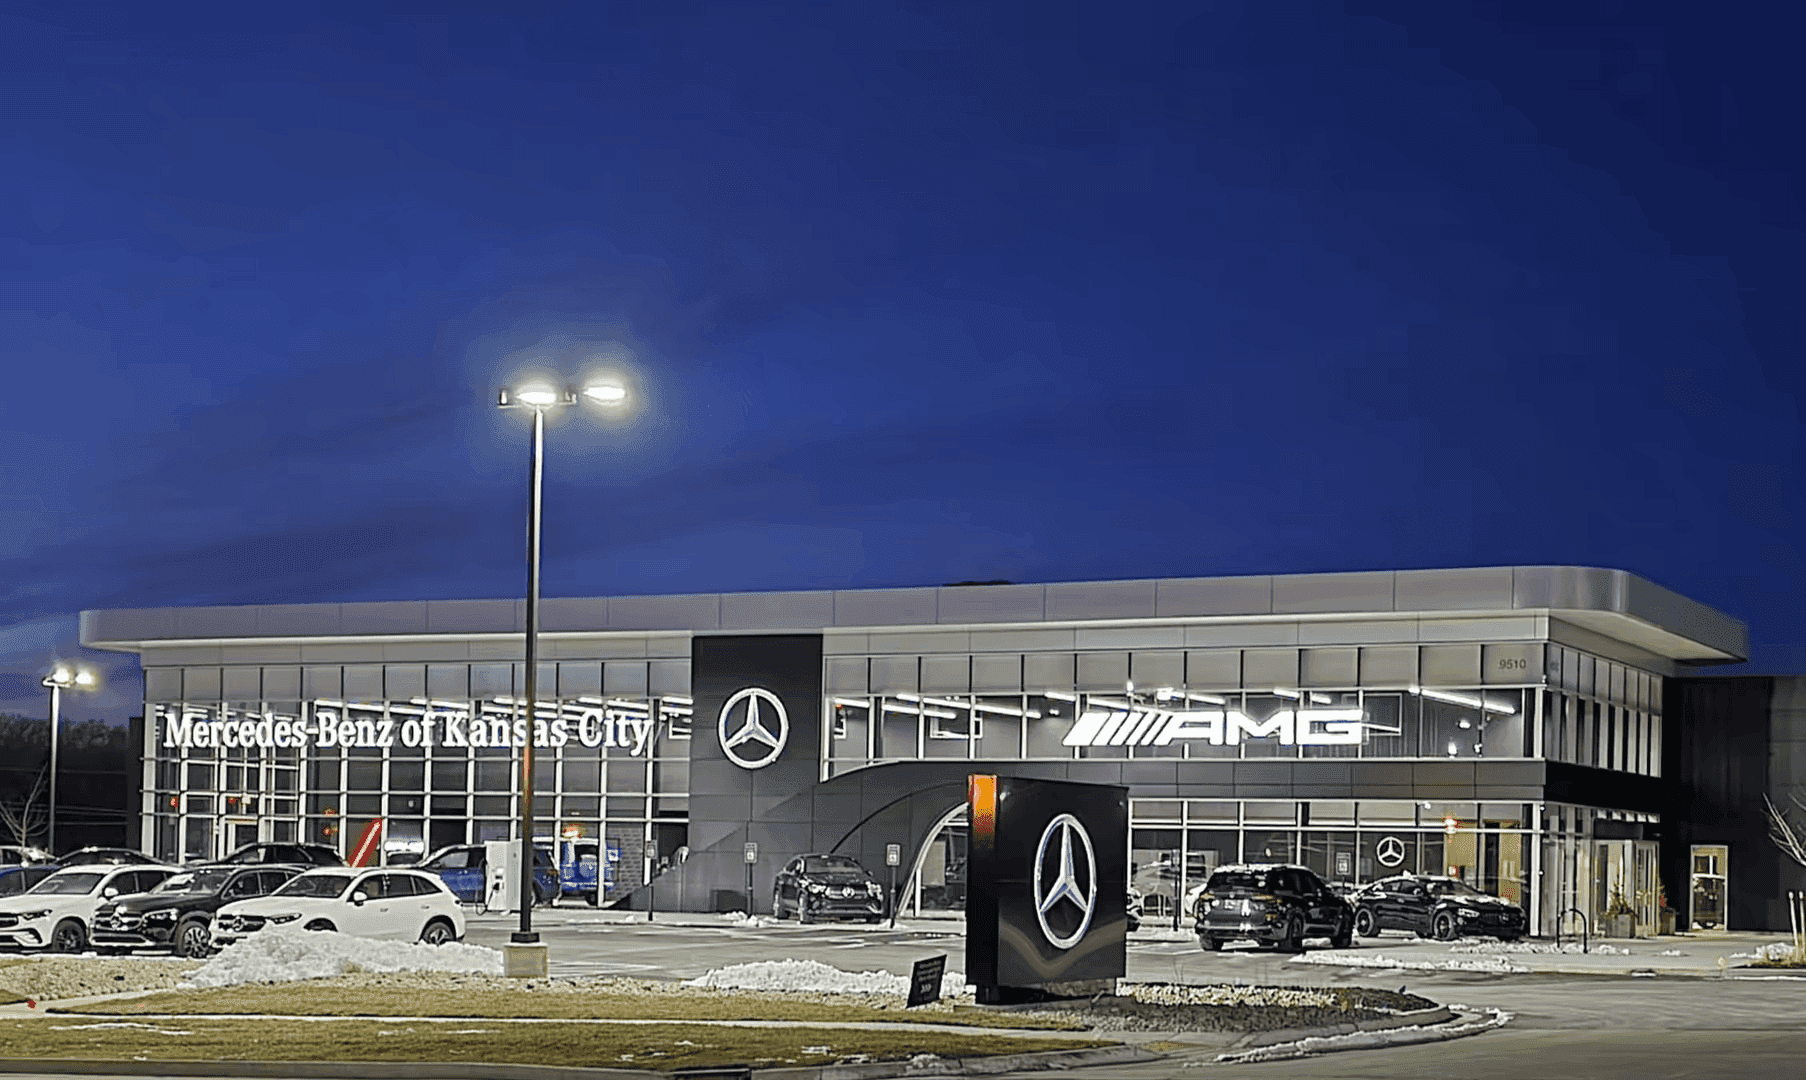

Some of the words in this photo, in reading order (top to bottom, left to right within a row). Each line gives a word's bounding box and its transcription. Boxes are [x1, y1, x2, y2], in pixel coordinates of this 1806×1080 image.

[1499, 658, 1527, 670] 9510
[163, 711, 394, 748] Mercedes-Benz
[401, 710, 436, 748] of
[442, 711, 570, 748] Kansas
[578, 709, 655, 757] City
[1152, 709, 1364, 746] AMG
